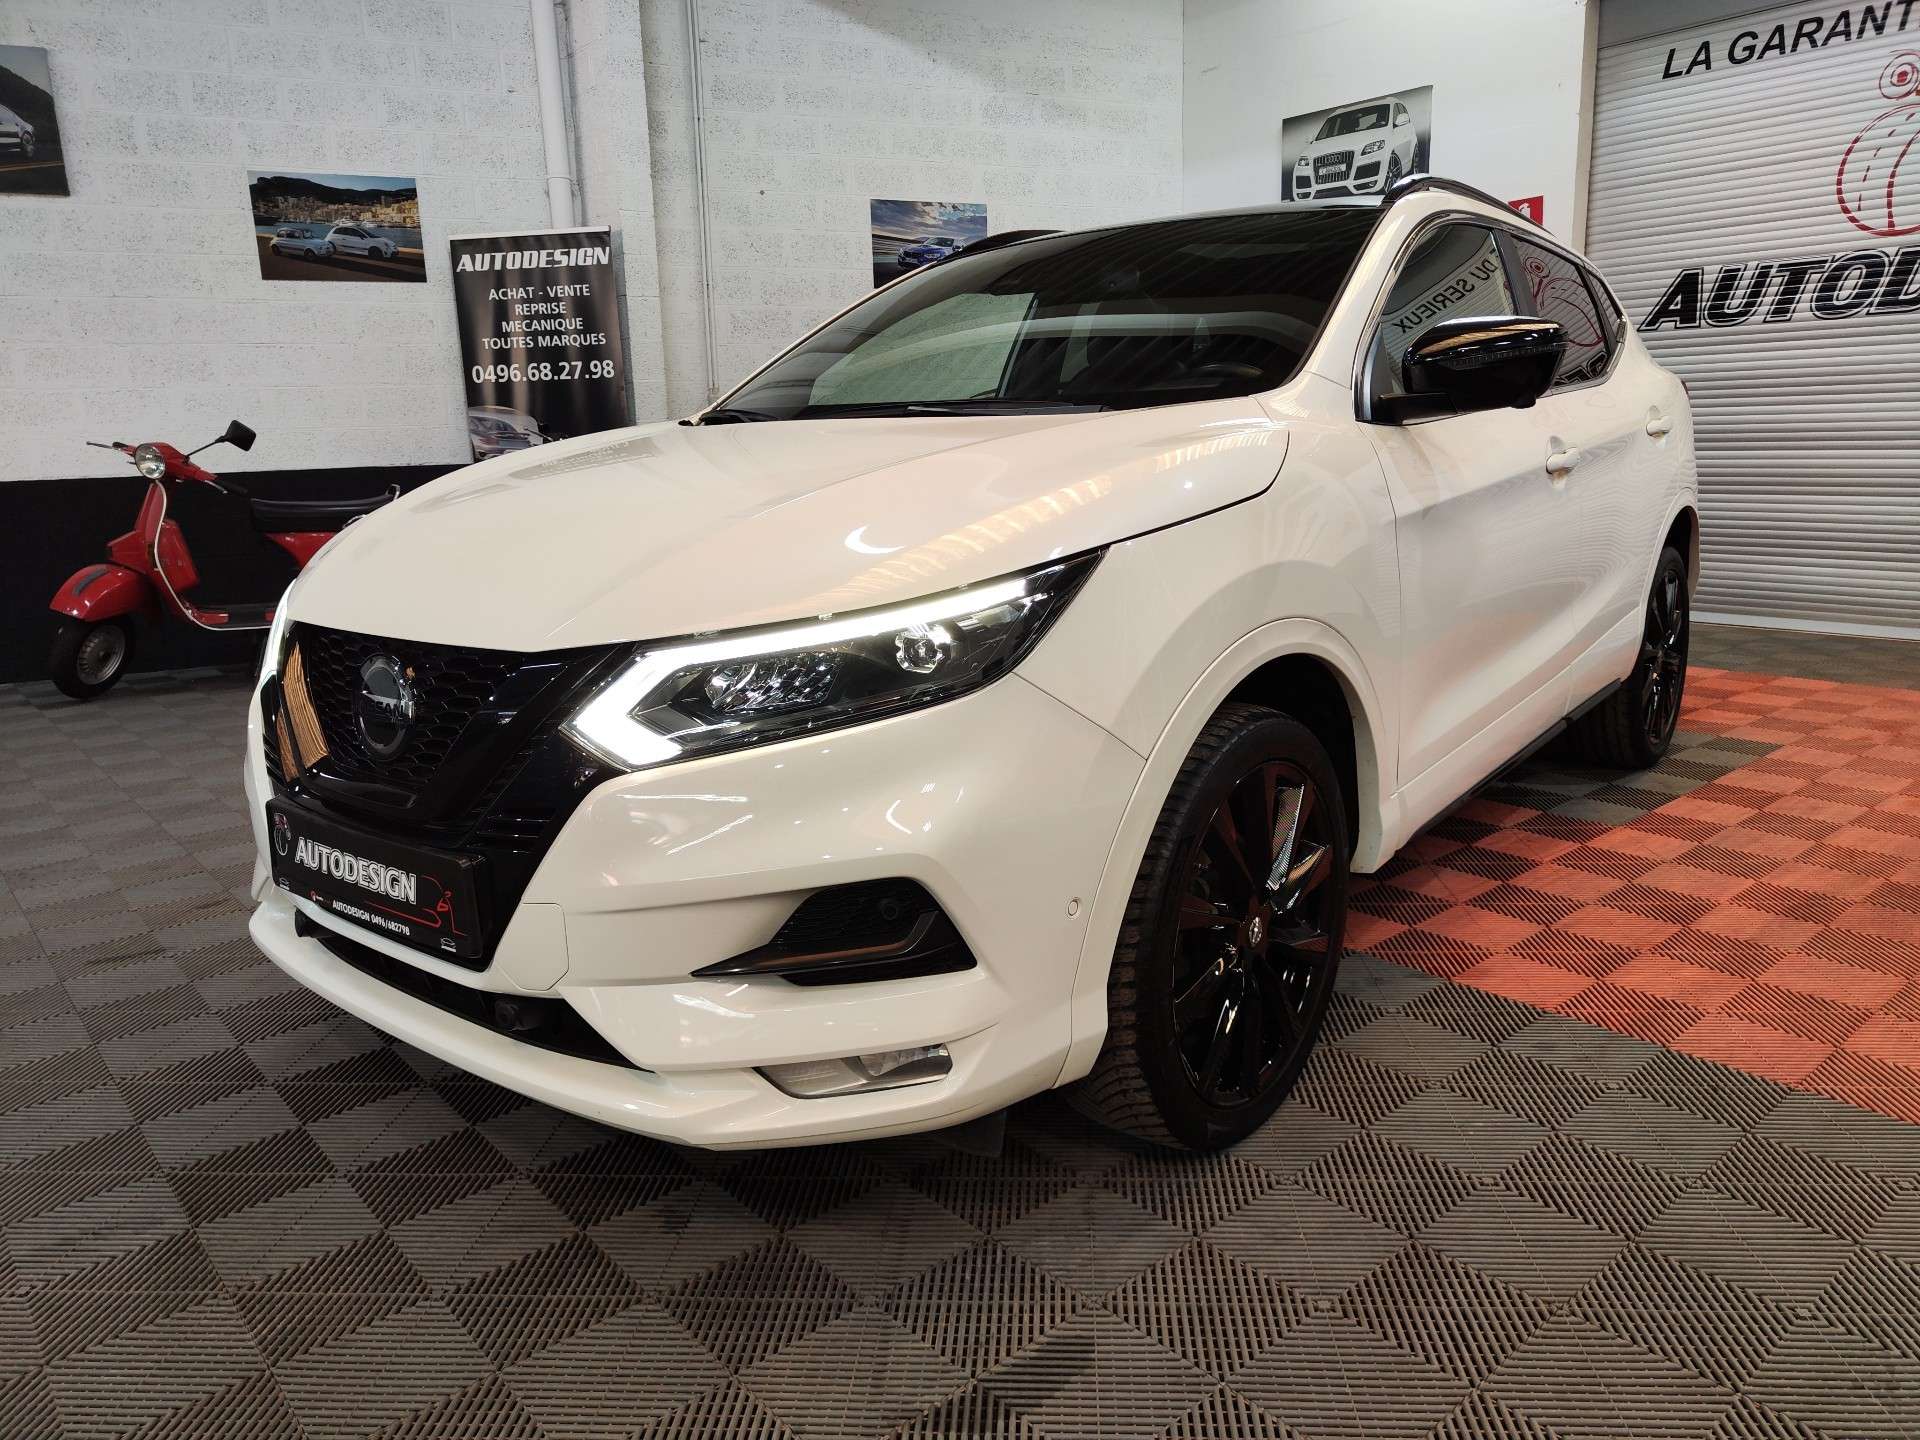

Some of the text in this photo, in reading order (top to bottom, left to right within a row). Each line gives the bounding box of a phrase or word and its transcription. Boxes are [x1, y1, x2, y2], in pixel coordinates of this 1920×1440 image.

[1662, 0, 1920, 80] LA GARANT
[456, 247, 610, 272] AUTODESIGN
[488, 286, 535, 301] ACHAT
[546, 284, 591, 298] VENTE
[514, 302, 567, 316] REPRISE
[501, 317, 584, 333] MECANIQUE
[482, 333, 607, 350] TOUTES MARQUES
[471, 359, 616, 384] 0496.68.27.98
[294, 836, 417, 905] AUTODESIGN
[332, 899, 411, 936] AUTODESIGN 0496/682798
